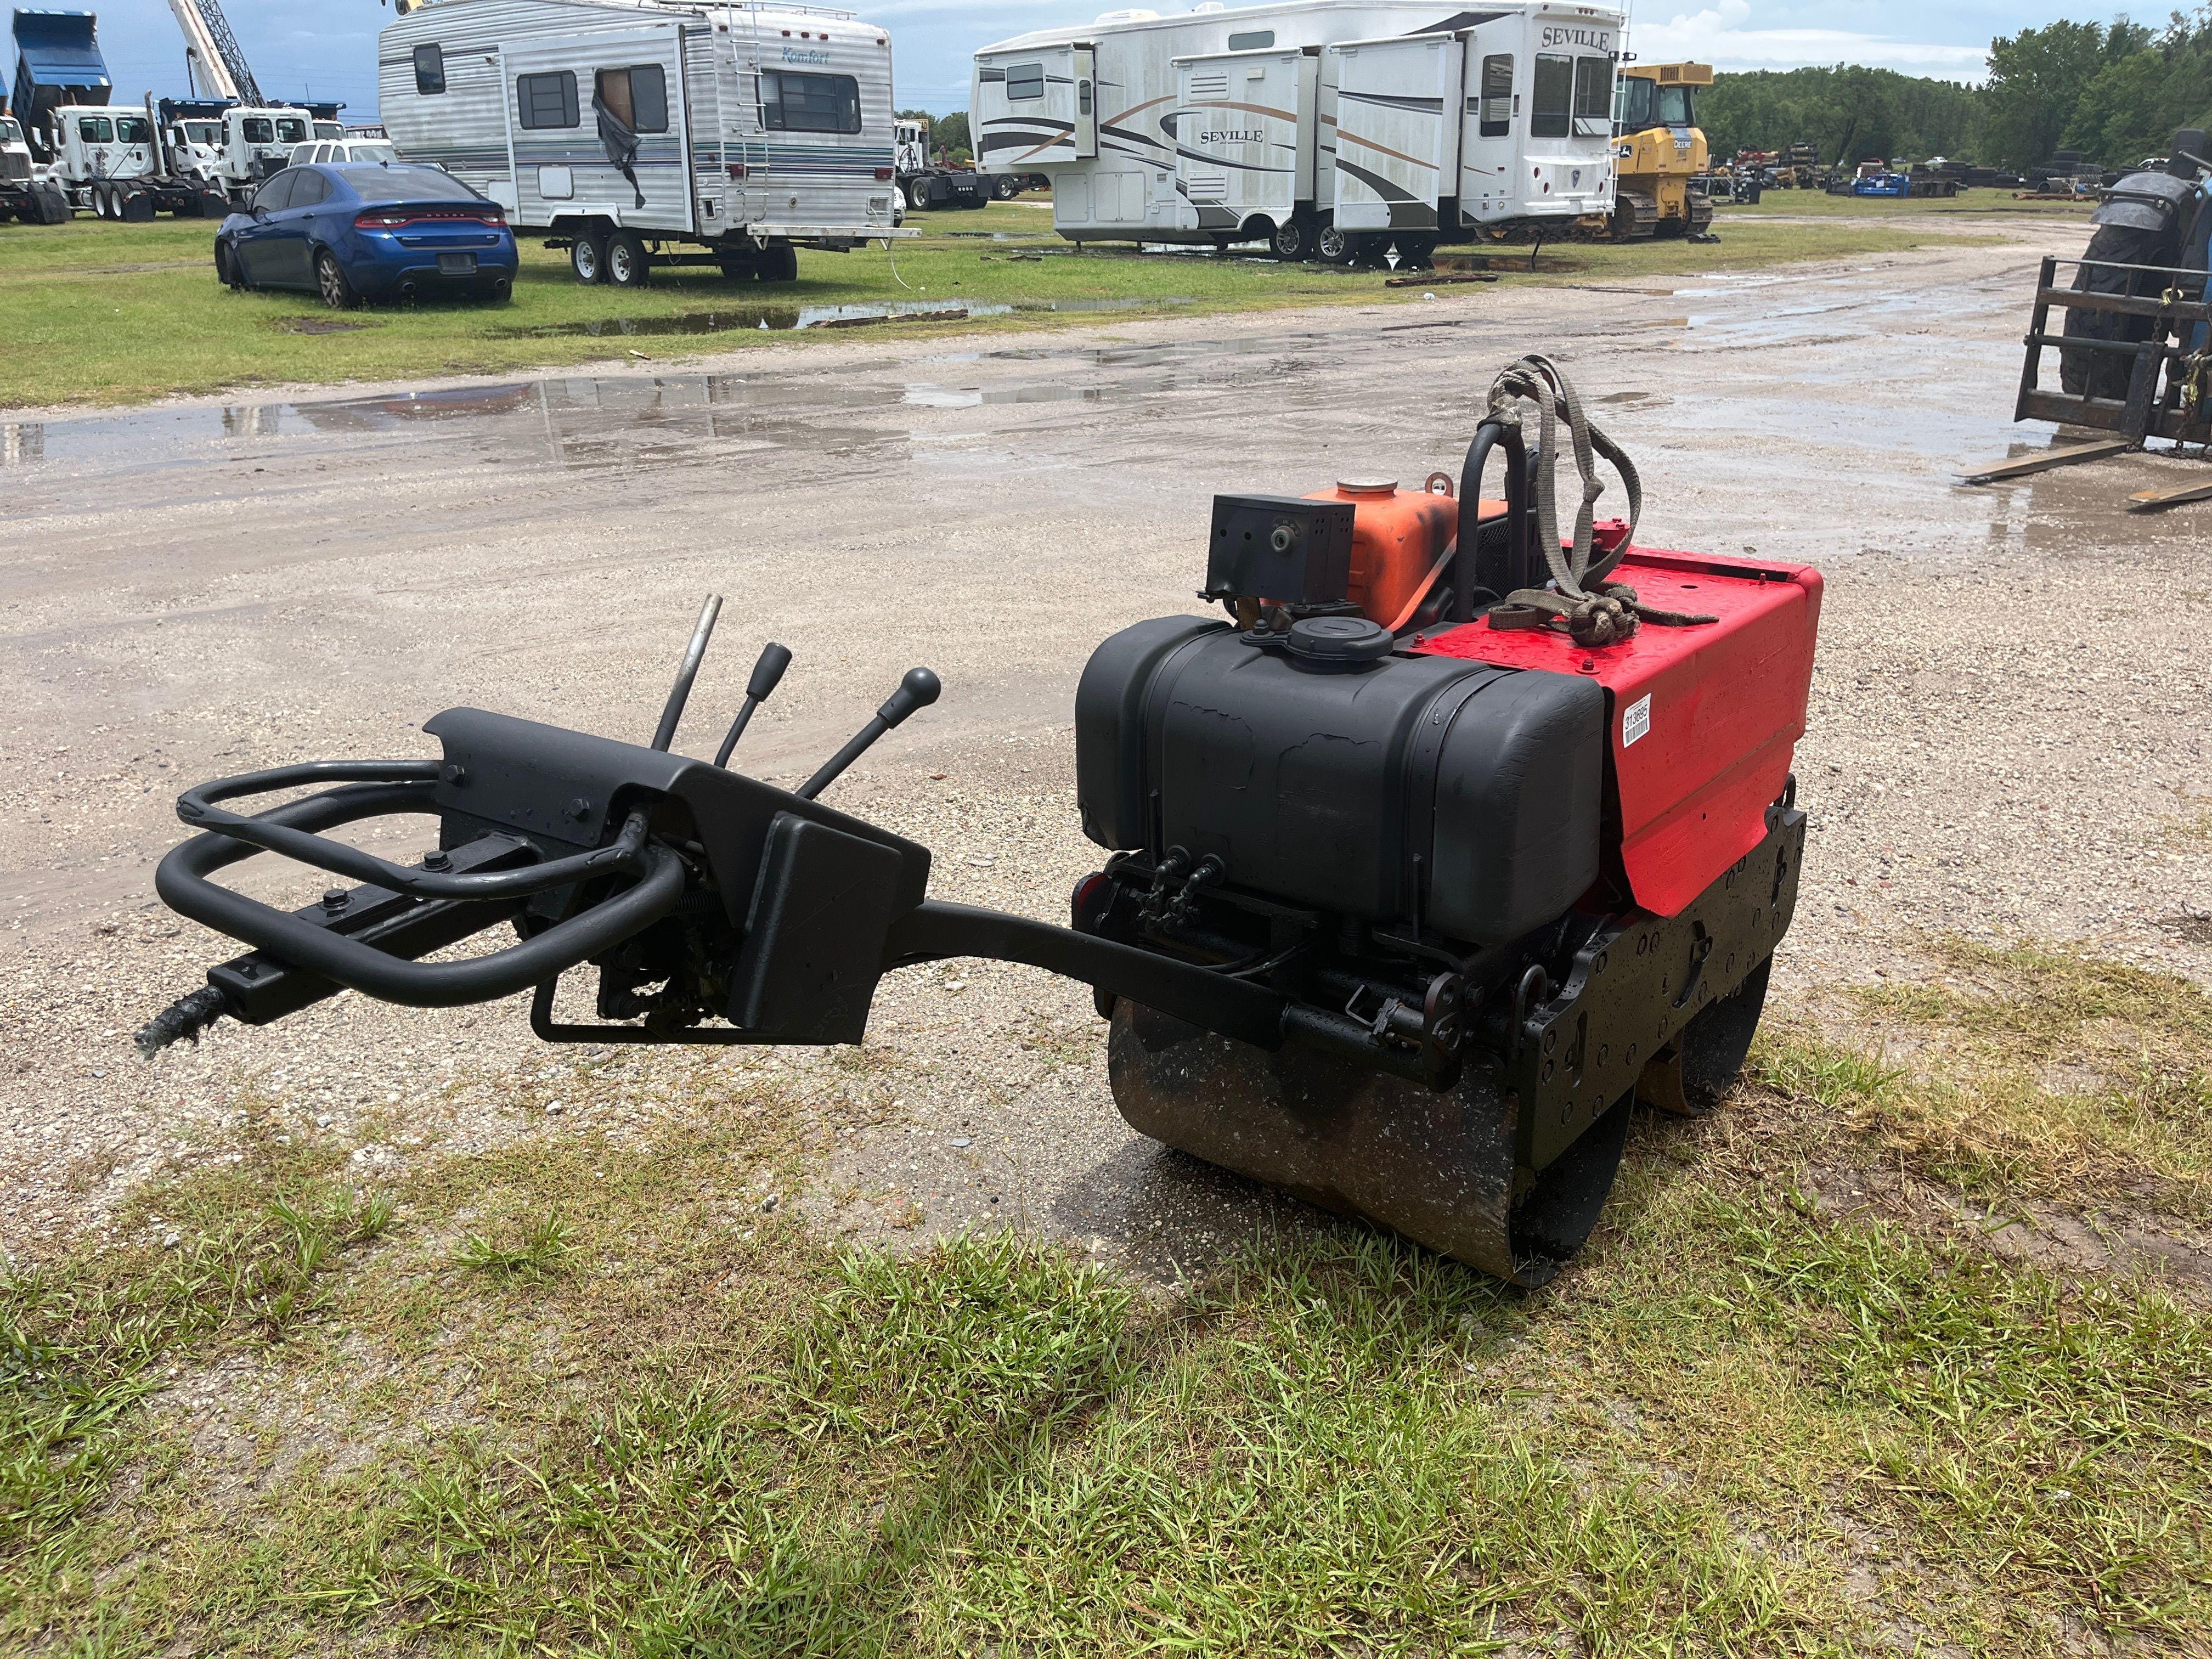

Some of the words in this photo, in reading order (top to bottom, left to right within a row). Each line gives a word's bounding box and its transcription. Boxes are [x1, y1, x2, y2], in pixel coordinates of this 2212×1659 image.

[1542, 27, 1609, 53] SEVILLE
[781, 47, 830, 64] Komfort
[1201, 130, 1263, 144] SEVILLE
[1625, 704, 1647, 730] 313695
